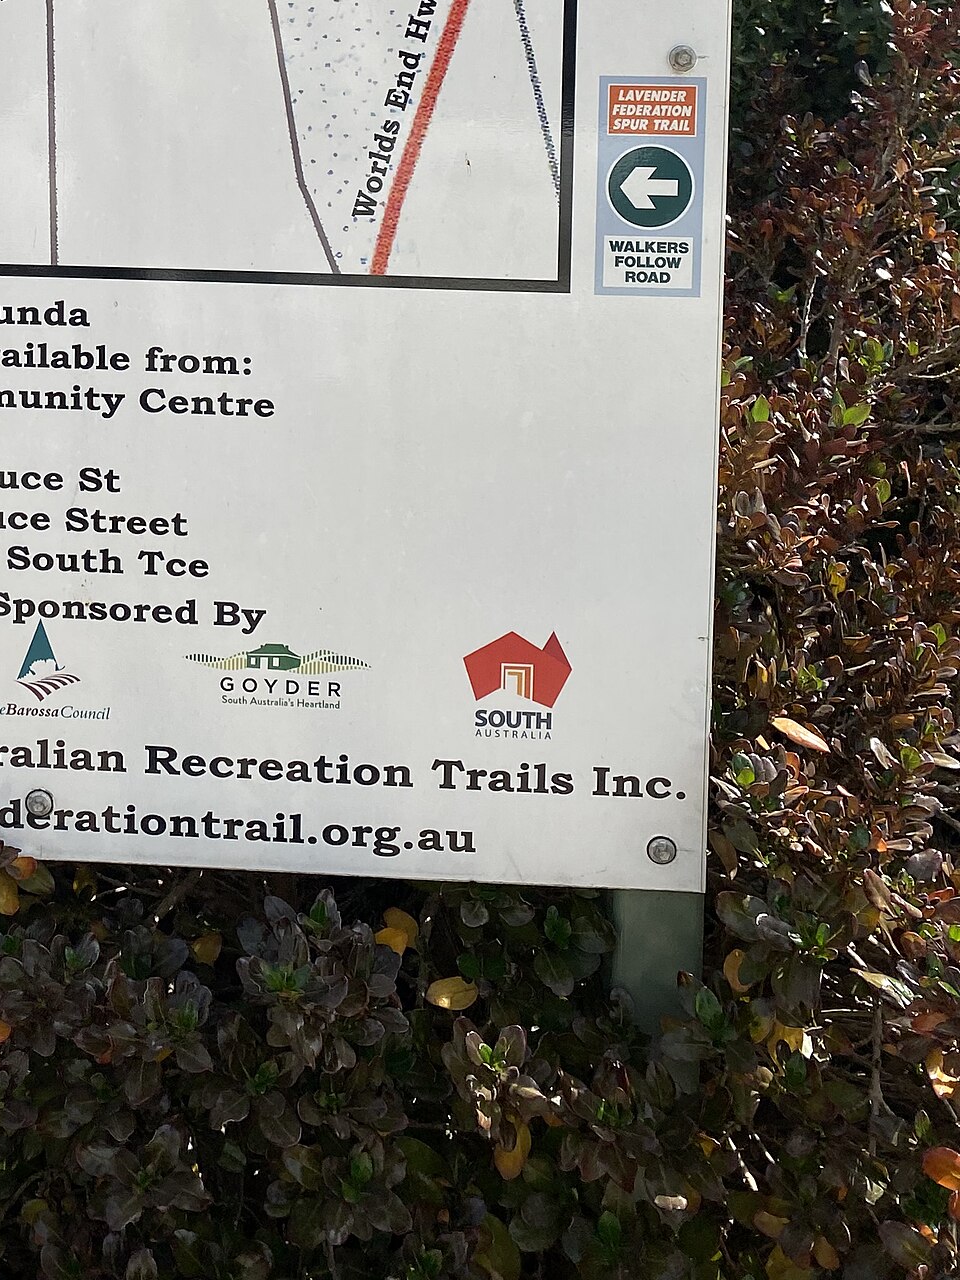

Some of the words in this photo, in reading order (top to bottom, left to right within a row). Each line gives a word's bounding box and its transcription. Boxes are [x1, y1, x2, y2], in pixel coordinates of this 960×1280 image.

[618, 90, 686, 102] LAVENDER
[612, 104, 692, 117] FEDERATION
[613, 119, 648, 130] SPUR
[653, 120, 690, 132] TRAIL
[351, 118, 401, 222] Worlds
[384, 51, 422, 111] End
[609, 240, 689, 253] WALKERS
[614, 256, 682, 268] FOLLOW
[625, 271, 671, 283] ROAD
[145, 347, 252, 375] from:
[139, 389, 275, 417] Centre
[79, 467, 121, 493] St
[65, 508, 188, 536] Street
[7, 546, 124, 574] South
[138, 550, 209, 578] Tce
[213, 601, 266, 634] By
[220, 676, 341, 697] GOYDER
[221, 695, 248, 705] South
[249, 697, 294, 707] Australia's
[297, 699, 340, 710] Heartland
[474, 710, 552, 730] SOUTH
[475, 729, 552, 740] AUSTRALIA
[145, 745, 414, 788] Recreation
[431, 759, 574, 795] Trails
[592, 766, 686, 800] Inc.
